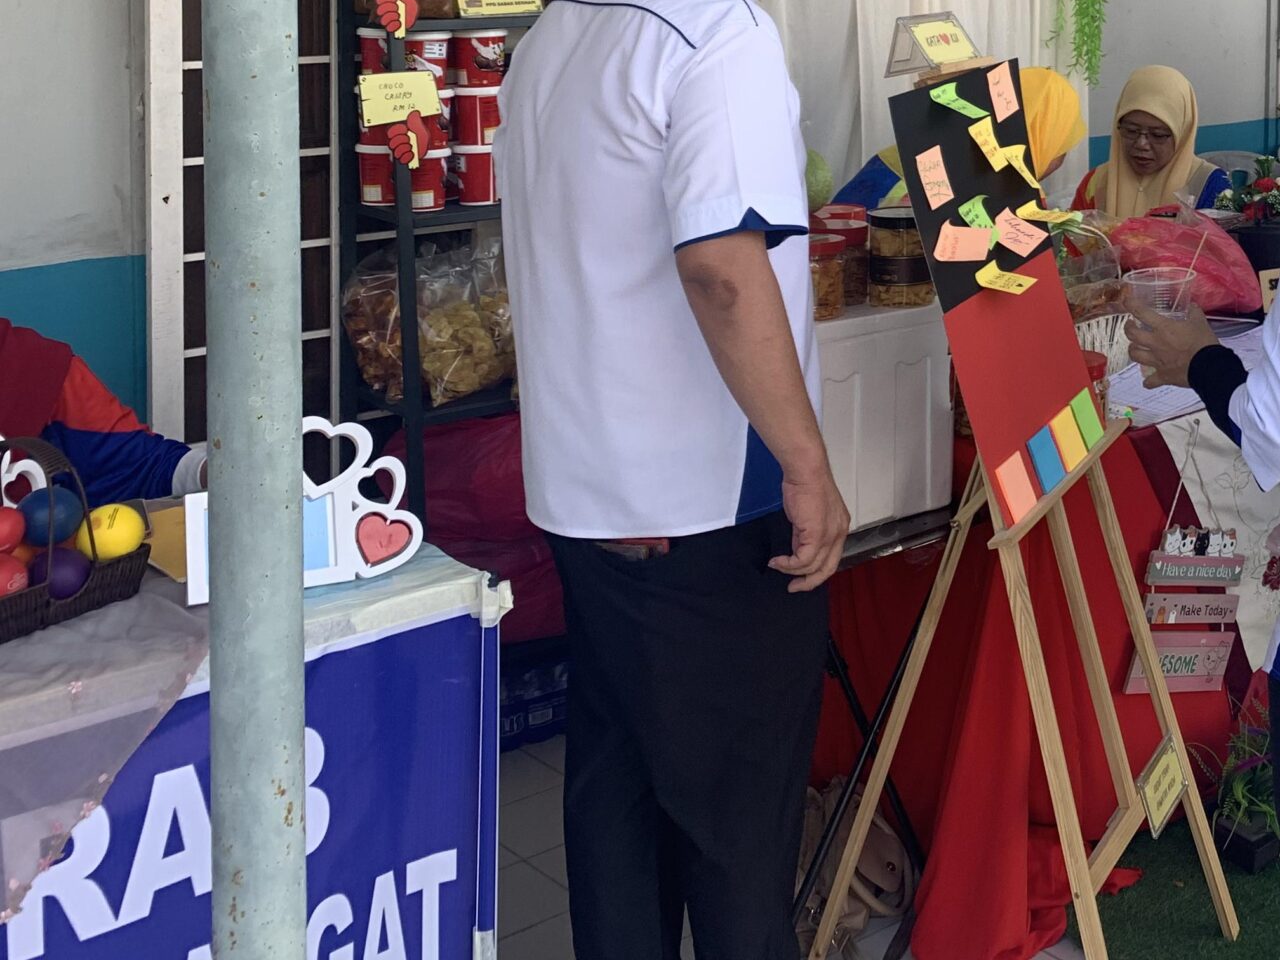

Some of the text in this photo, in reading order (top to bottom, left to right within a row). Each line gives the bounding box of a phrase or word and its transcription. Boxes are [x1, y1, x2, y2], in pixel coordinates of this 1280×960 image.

[392, 104, 405, 112] RM
[1161, 562, 1232, 580] Have a nice day
[1179, 604, 1229, 619] Make Today
